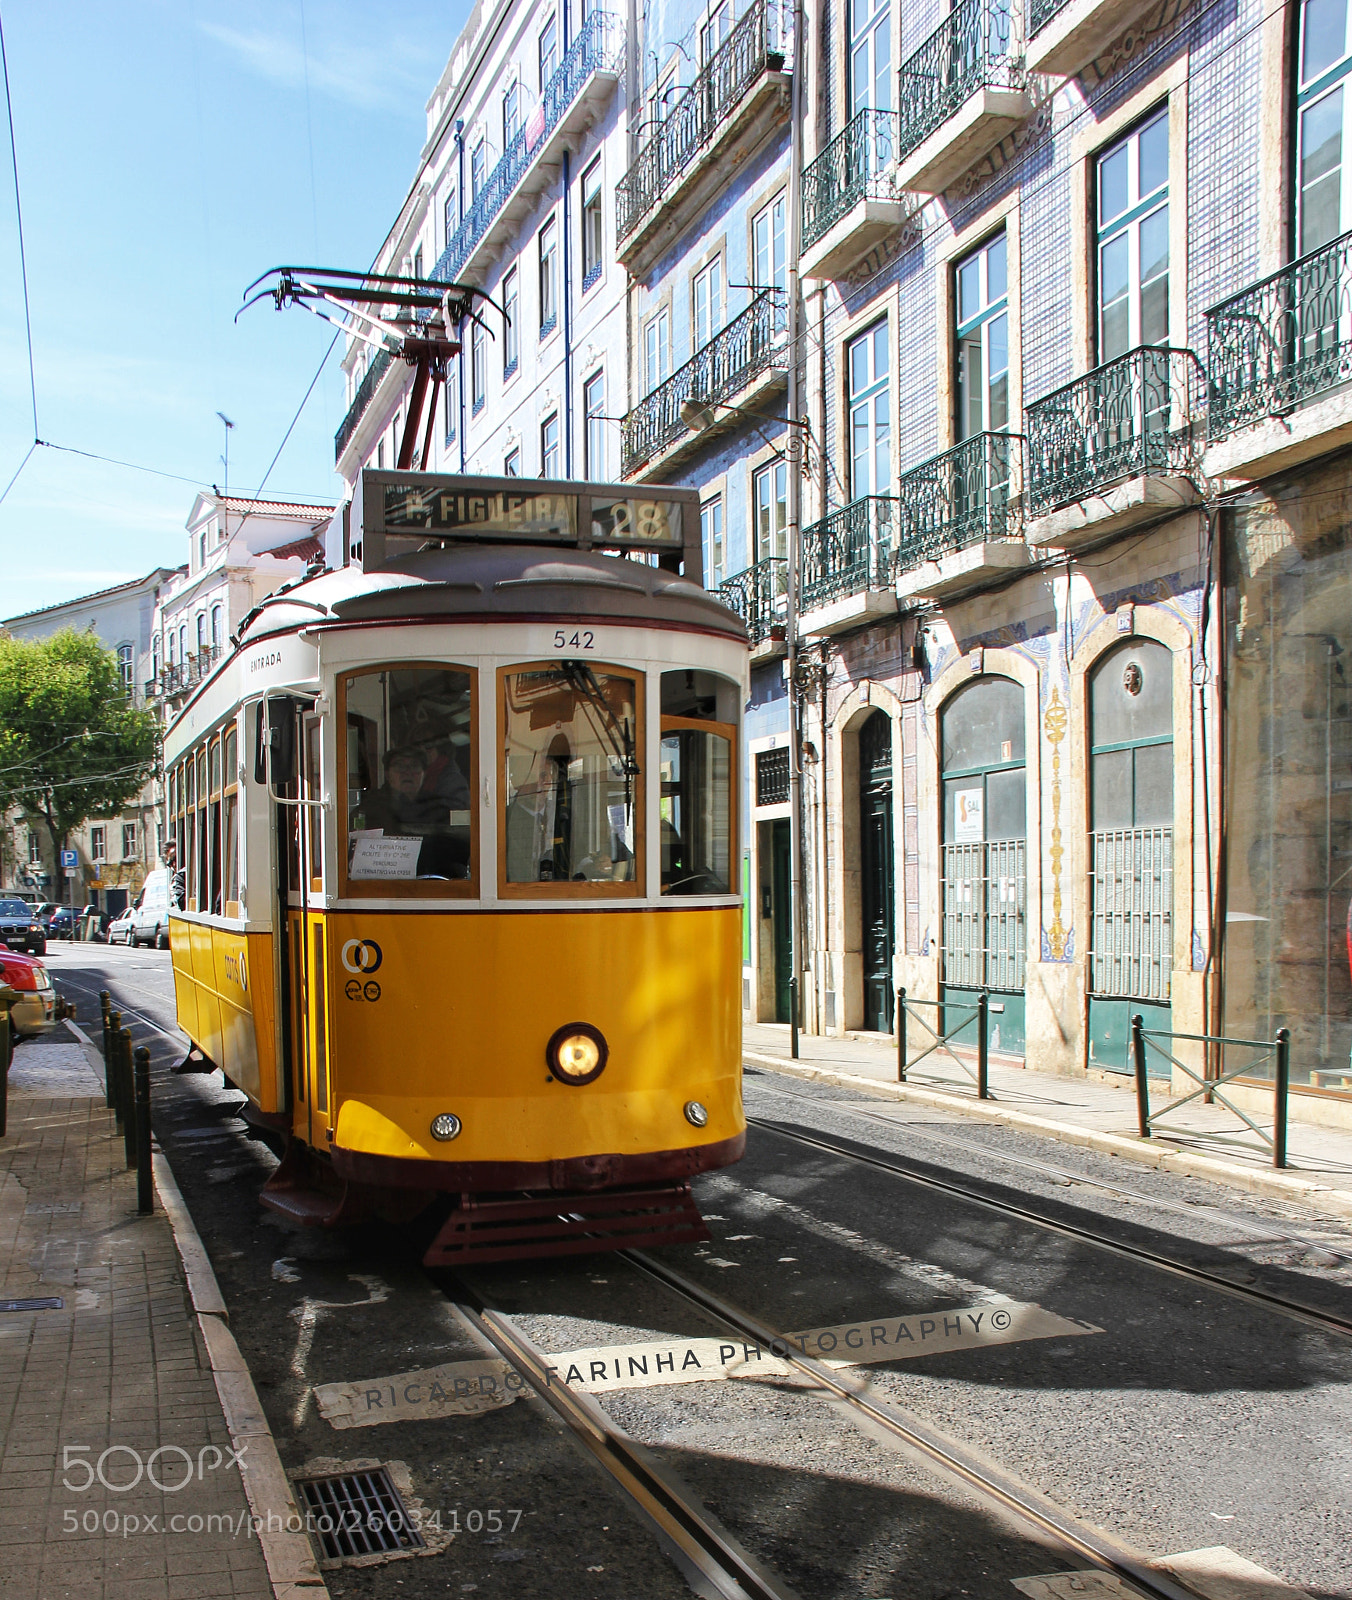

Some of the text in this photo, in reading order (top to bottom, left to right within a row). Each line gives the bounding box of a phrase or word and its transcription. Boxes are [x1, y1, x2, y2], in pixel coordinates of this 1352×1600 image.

[440, 495, 568, 523] FIGUEIRA
[609, 503, 663, 538] 28
[553, 630, 595, 649] 542
[250, 651, 282, 673] ENTRADA
[64, 852, 75, 866] P
